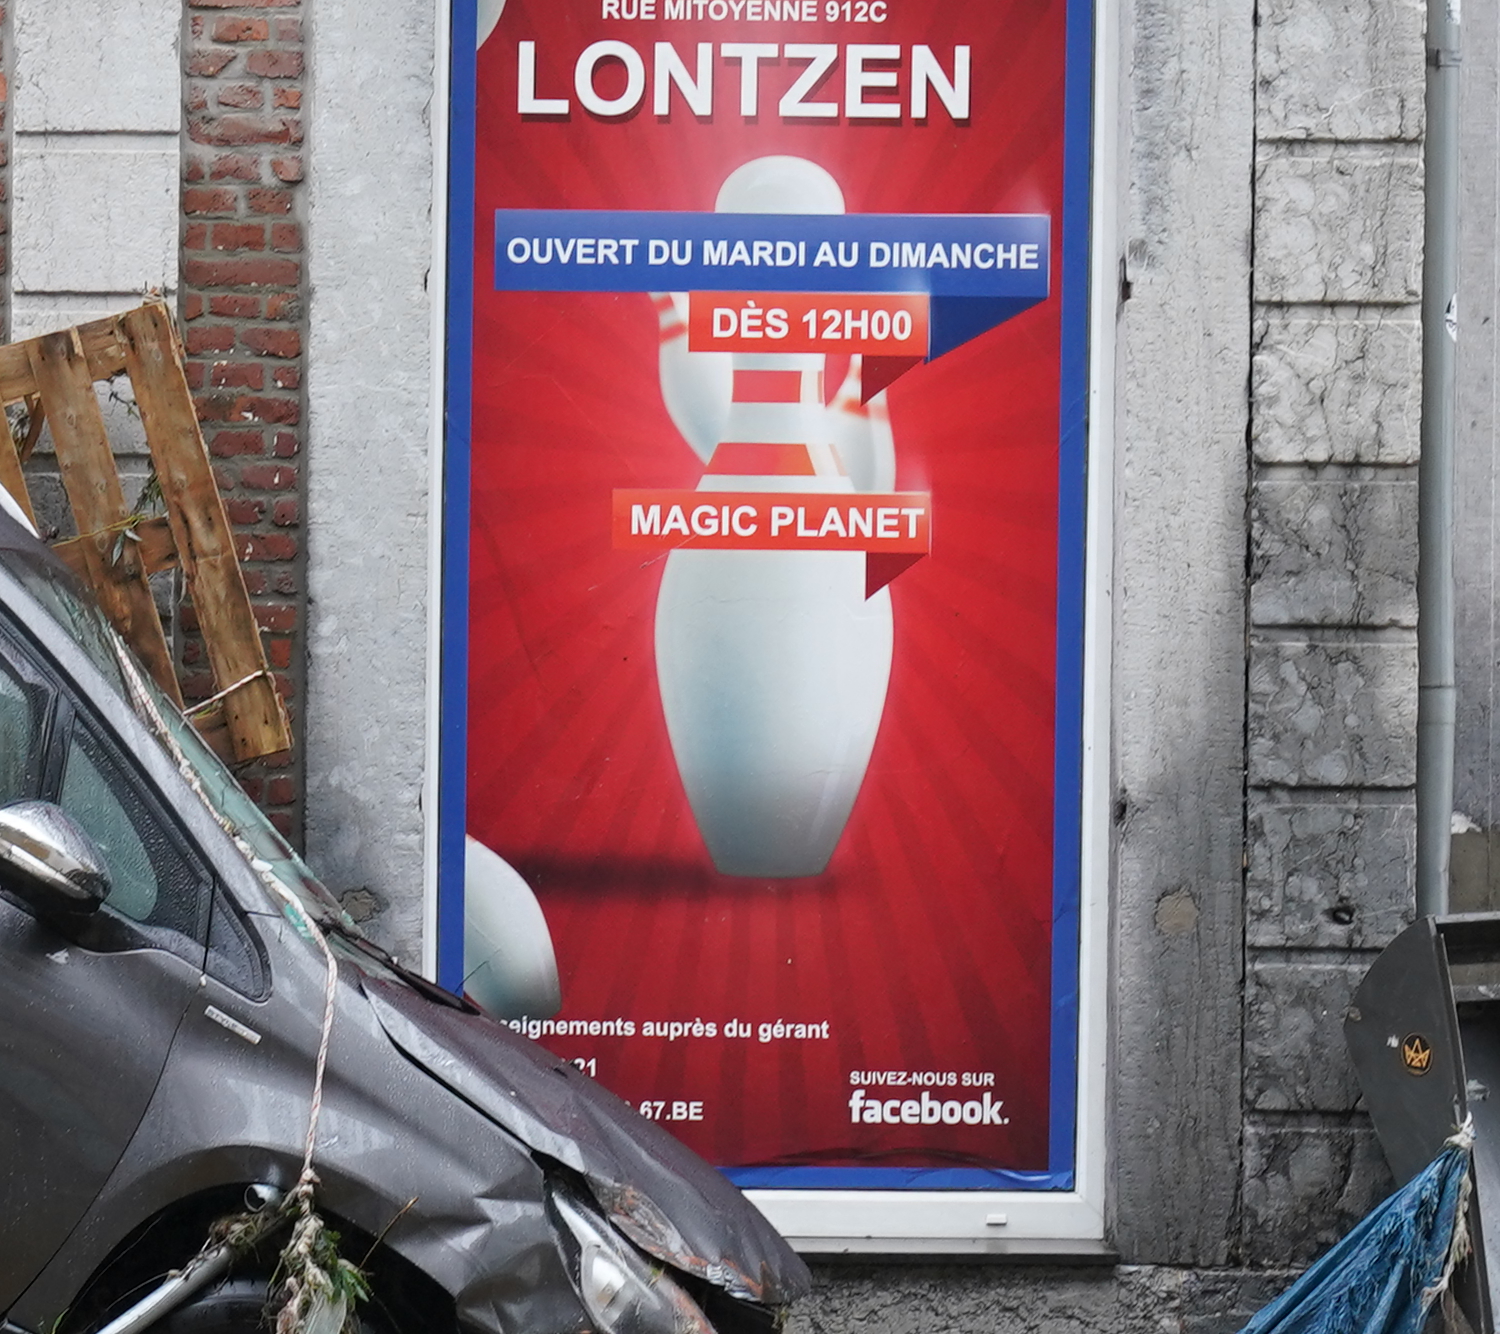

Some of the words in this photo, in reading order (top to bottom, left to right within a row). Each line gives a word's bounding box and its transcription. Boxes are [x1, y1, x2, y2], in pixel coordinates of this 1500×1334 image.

[825, 0, 887, 23] 912C
[517, 40, 970, 119] LONTZEN
[507, 237, 640, 265] OUVERT
[648, 239, 693, 266] DU
[703, 239, 806, 267] MARDI
[813, 241, 859, 268] AU
[869, 241, 1039, 270] DIMANCHE
[712, 300, 789, 339] DÈS
[802, 308, 912, 341] 12H00
[631, 504, 758, 537] MAGIC
[771, 506, 926, 539] PLANET
[500, 1015, 636, 1040] eignements
[642, 1017, 718, 1041] auprès
[723, 1018, 752, 1038] du
[758, 1018, 830, 1043] gérant
[849, 1070, 958, 1086] SUIVEZ-NOUS
[961, 1072, 995, 1087] SUR
